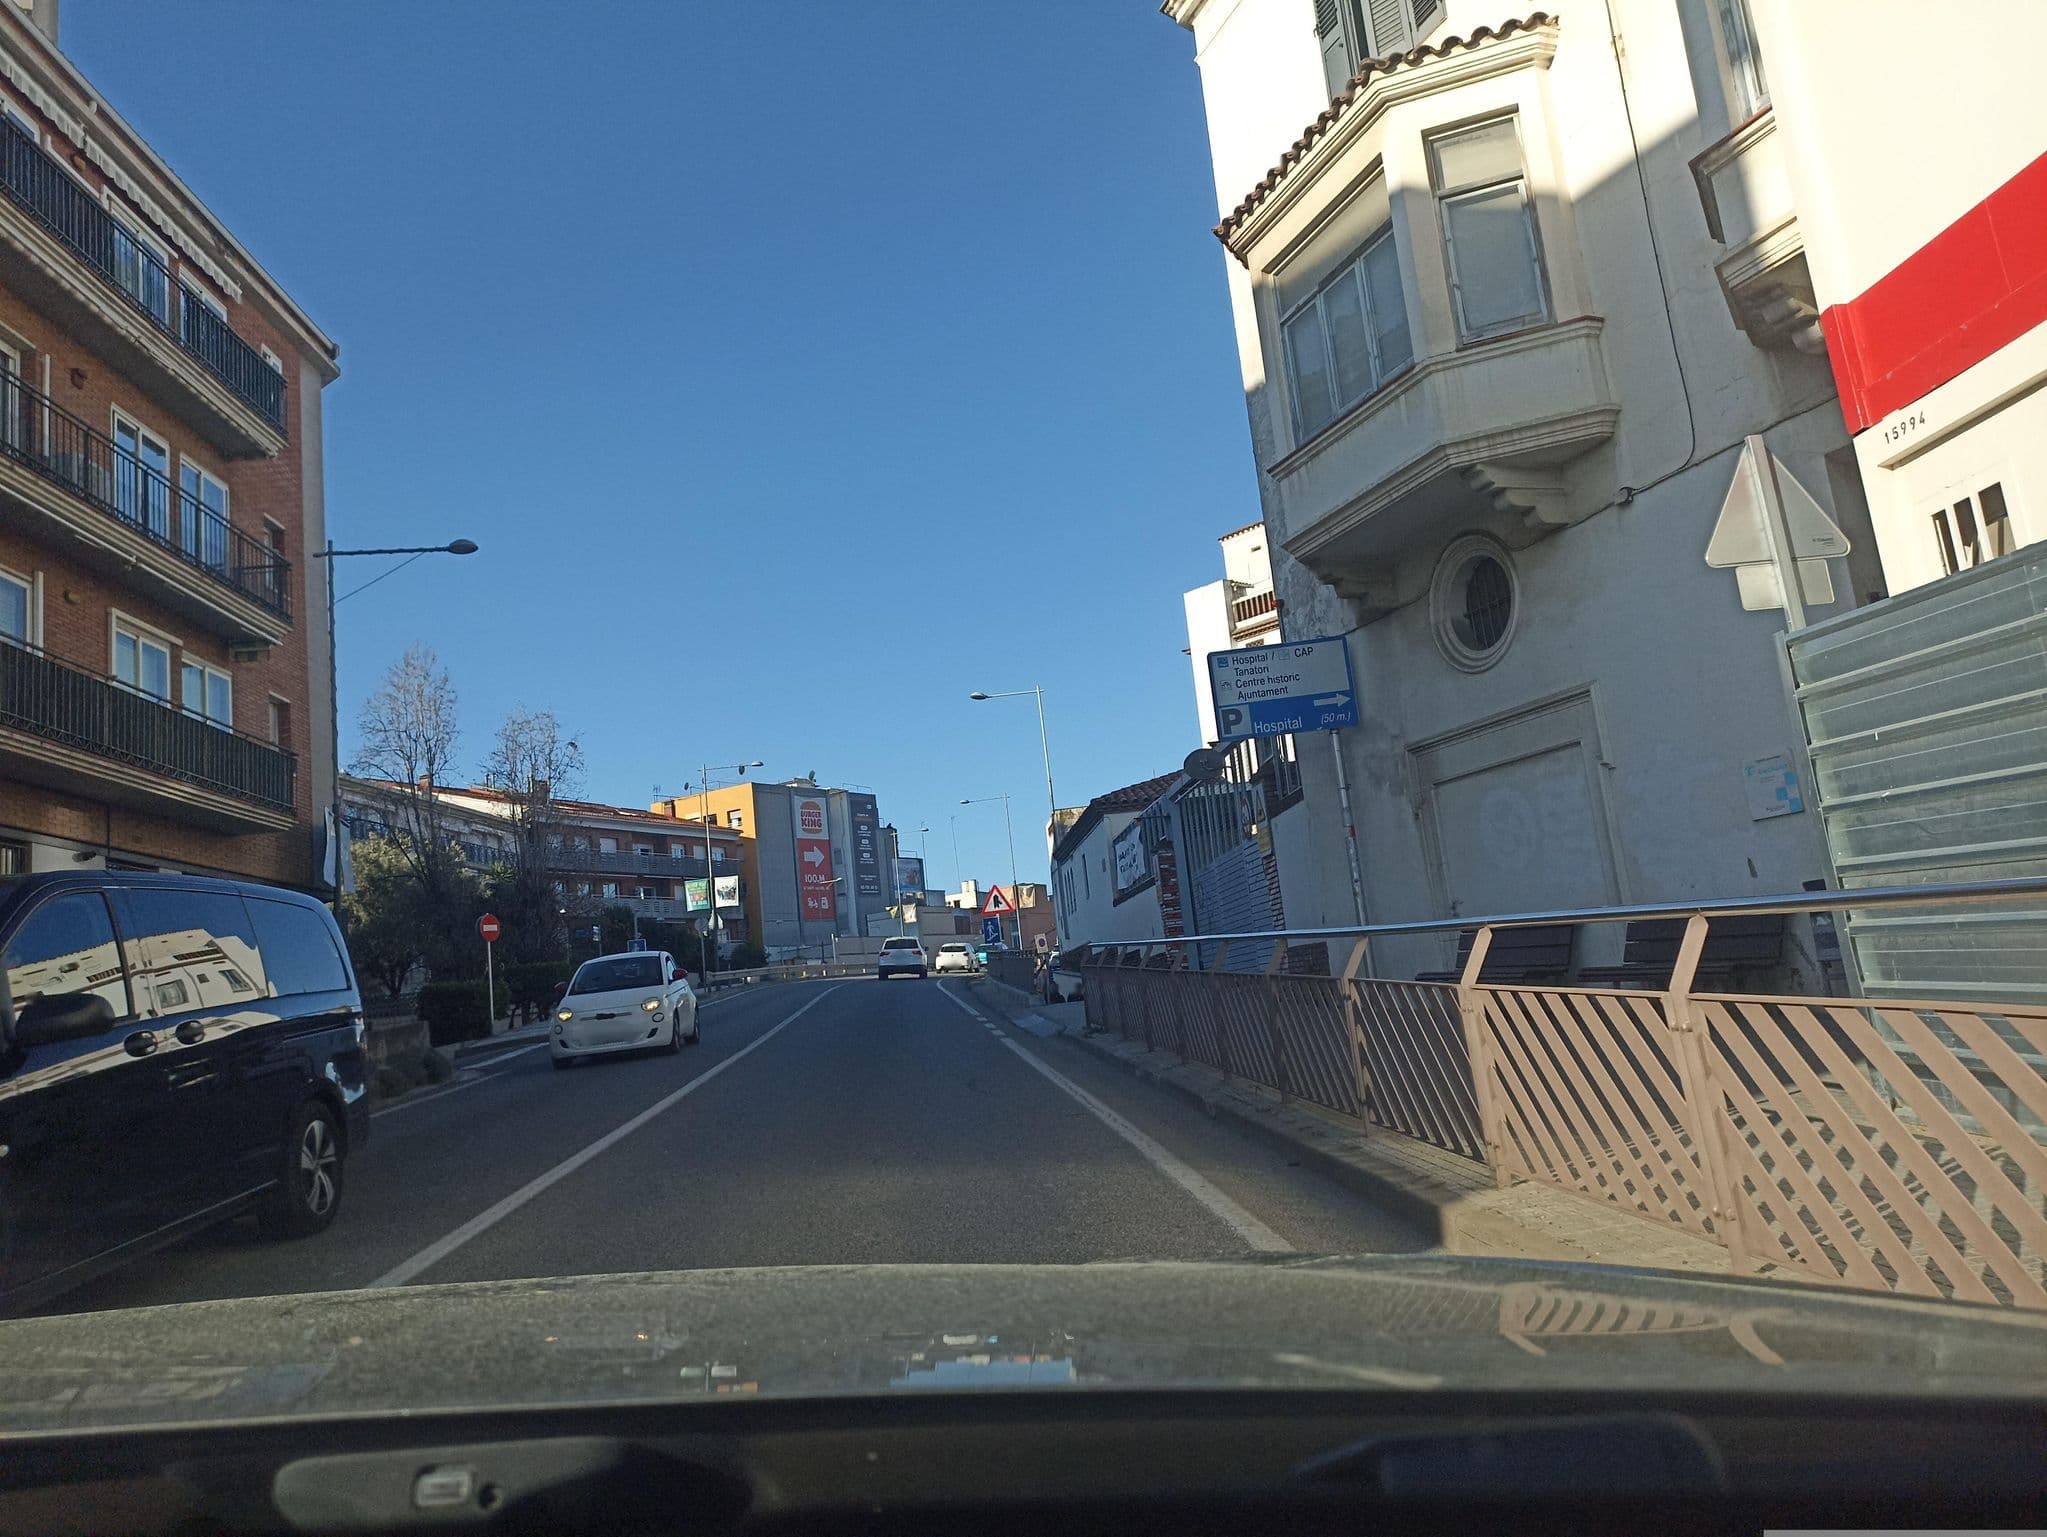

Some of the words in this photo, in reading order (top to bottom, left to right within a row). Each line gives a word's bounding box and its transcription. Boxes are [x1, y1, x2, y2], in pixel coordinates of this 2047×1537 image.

[1885, 411, 1925, 444] 15994
[1232, 652, 1268, 665] Hospital
[1294, 646, 1313, 657] CAP
[1235, 677, 1265, 689] Centre
[1238, 686, 1288, 701] Ajuntament
[1254, 716, 1302, 734] Hospital
[801, 818, 822, 828] KING
